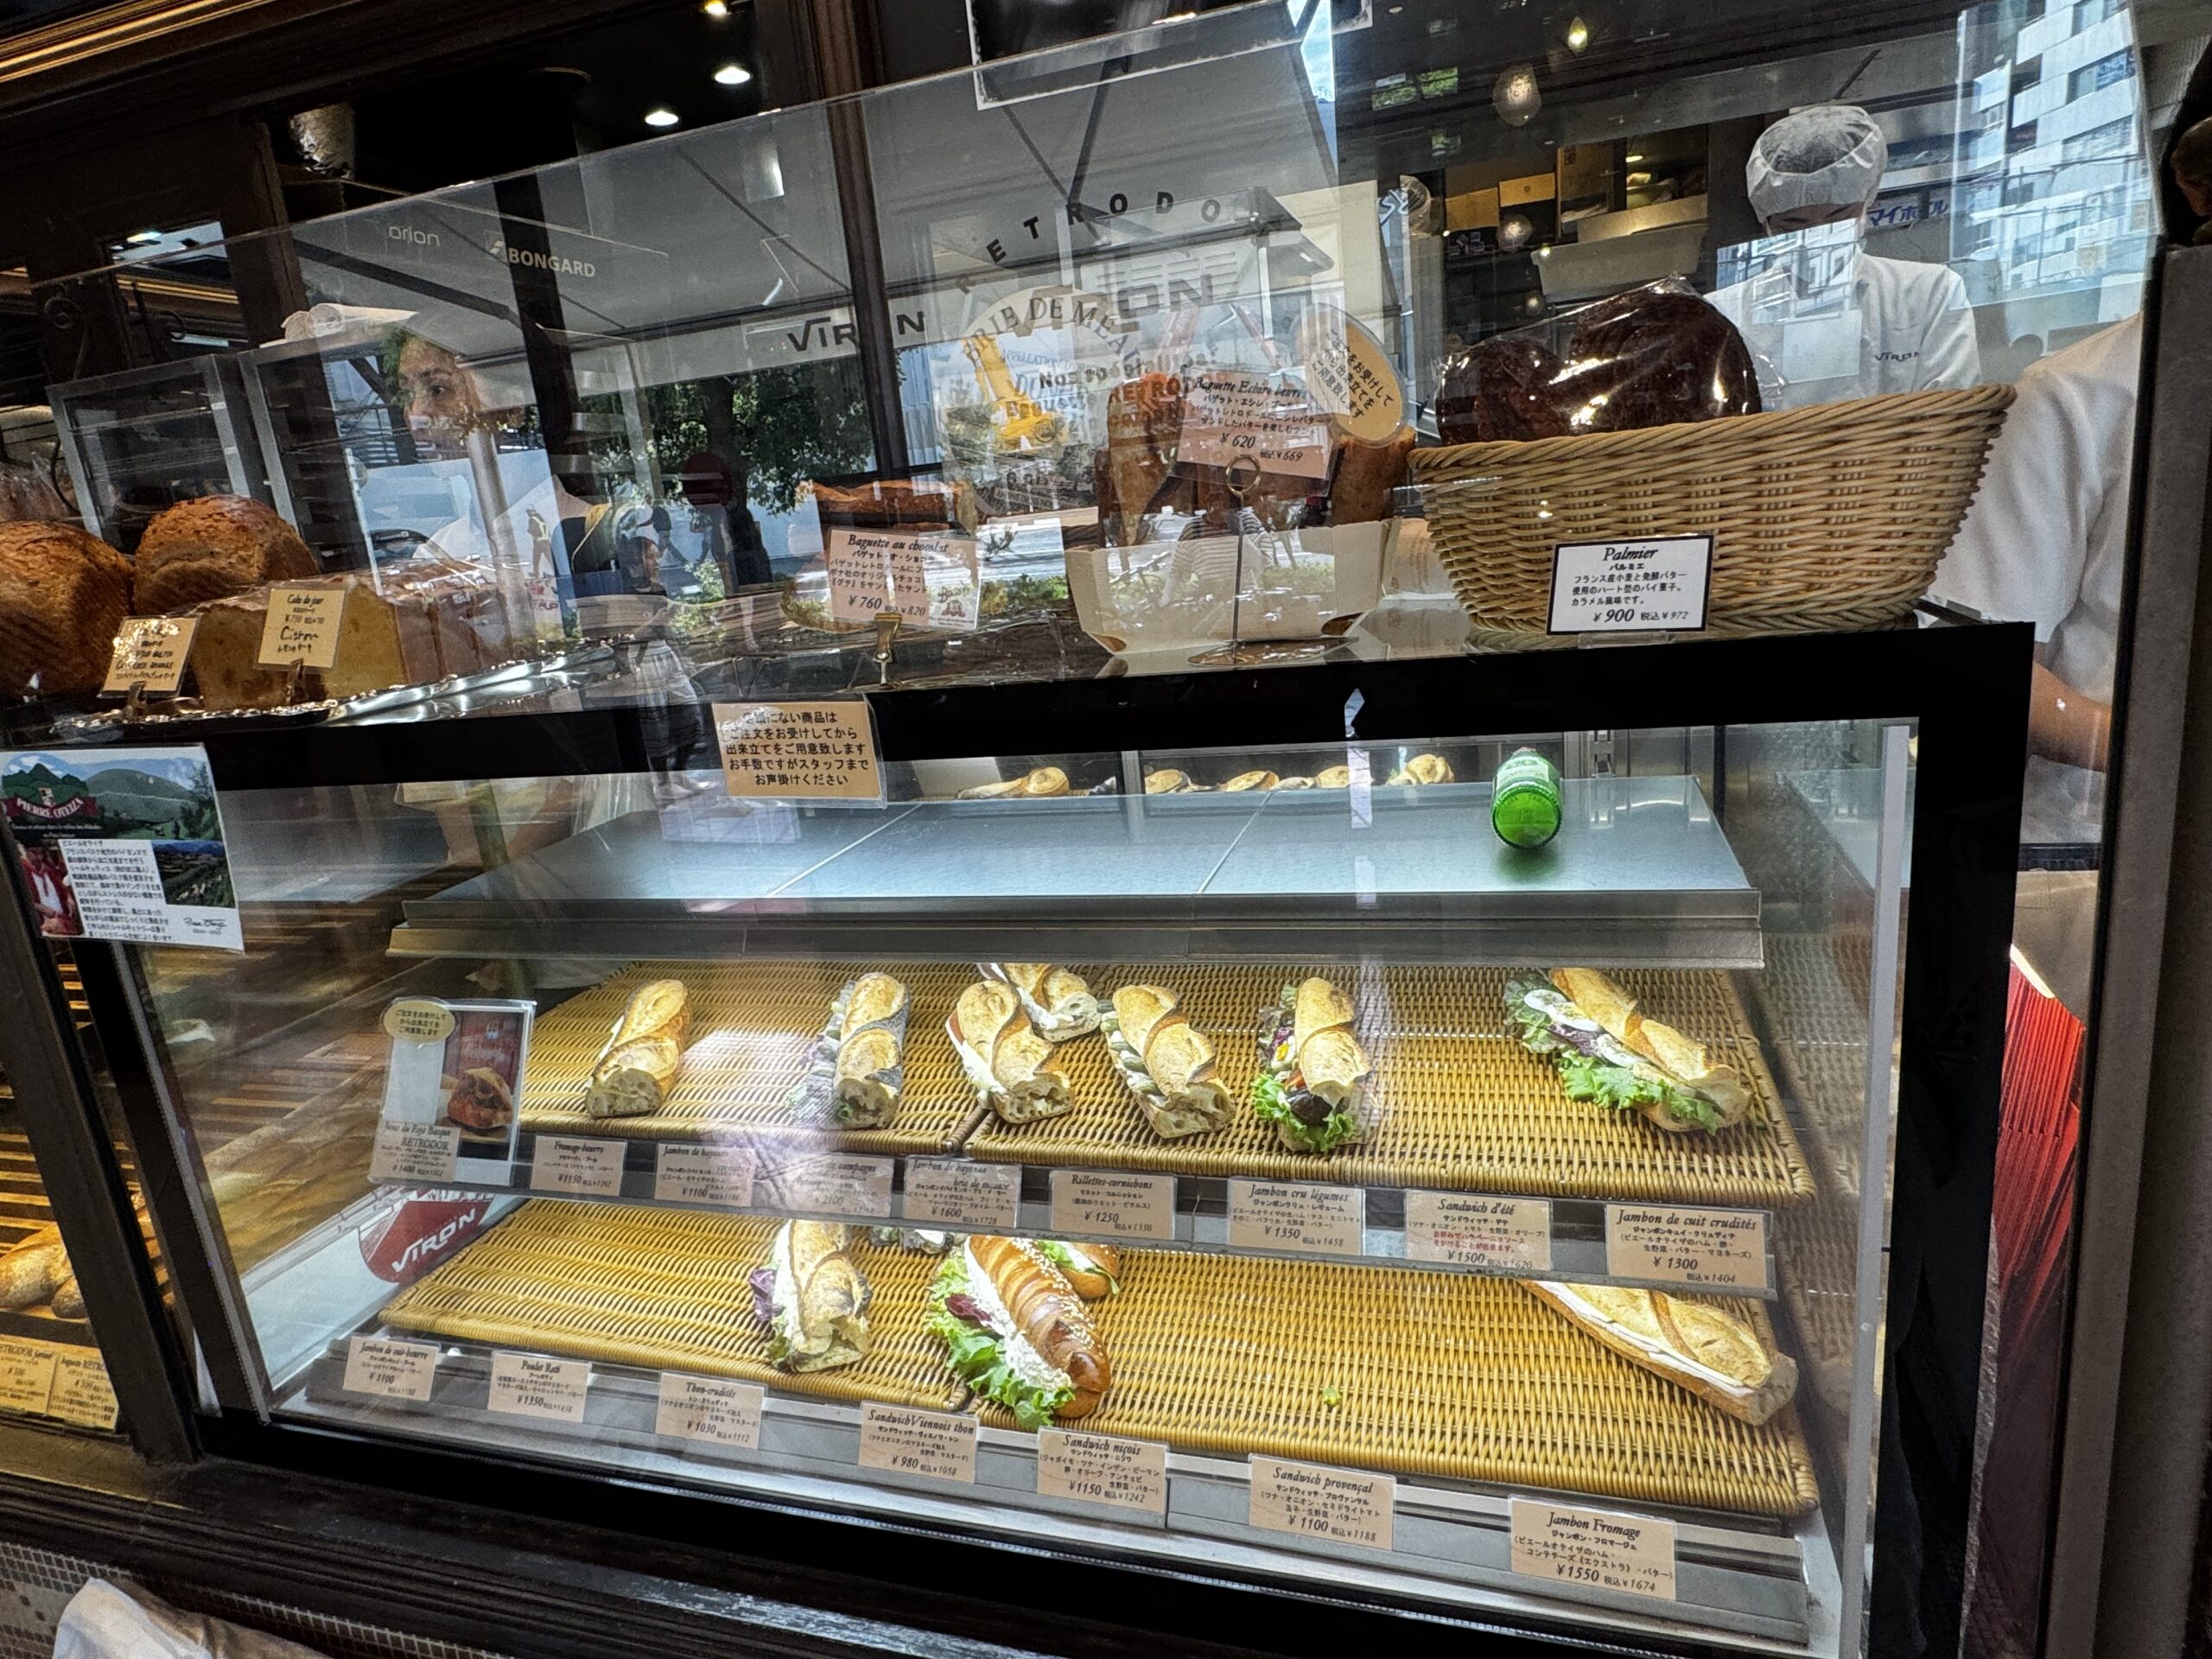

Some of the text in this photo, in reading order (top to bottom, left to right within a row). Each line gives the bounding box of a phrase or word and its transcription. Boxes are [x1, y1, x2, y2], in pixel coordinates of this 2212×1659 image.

[389, 225, 440, 247] orion
[508, 248, 596, 277] BONGARD
[1029, 297, 1064, 321] DE
[787, 311, 925, 352] VIRN
[848, 534, 890, 550] Baguette
[1603, 546, 1658, 562] Palmier
[726, 743, 866, 755] 出来立てをご用意致します
[729, 758, 869, 771] お手数ですがスタッフまで
[755, 773, 849, 786] お声掛けください
[1071, 1174, 1153, 1190] Rillettes-cornichons
[1249, 1184, 1287, 1198] Jambon
[1291, 1190, 1307, 1199] cru
[1438, 1198, 1489, 1214] Sandwich
[1616, 1209, 1758, 1230] Jambon de cuit crudités
[391, 1208, 476, 1273] VIRON
[868, 1409, 975, 1434] Sandwich Viennois thon
[1063, 1434, 1141, 1456] Sandwich niçois
[1273, 1466, 1374, 1495] Sandwich provençal
[1546, 1511, 1642, 1541] Jambon Fromage
